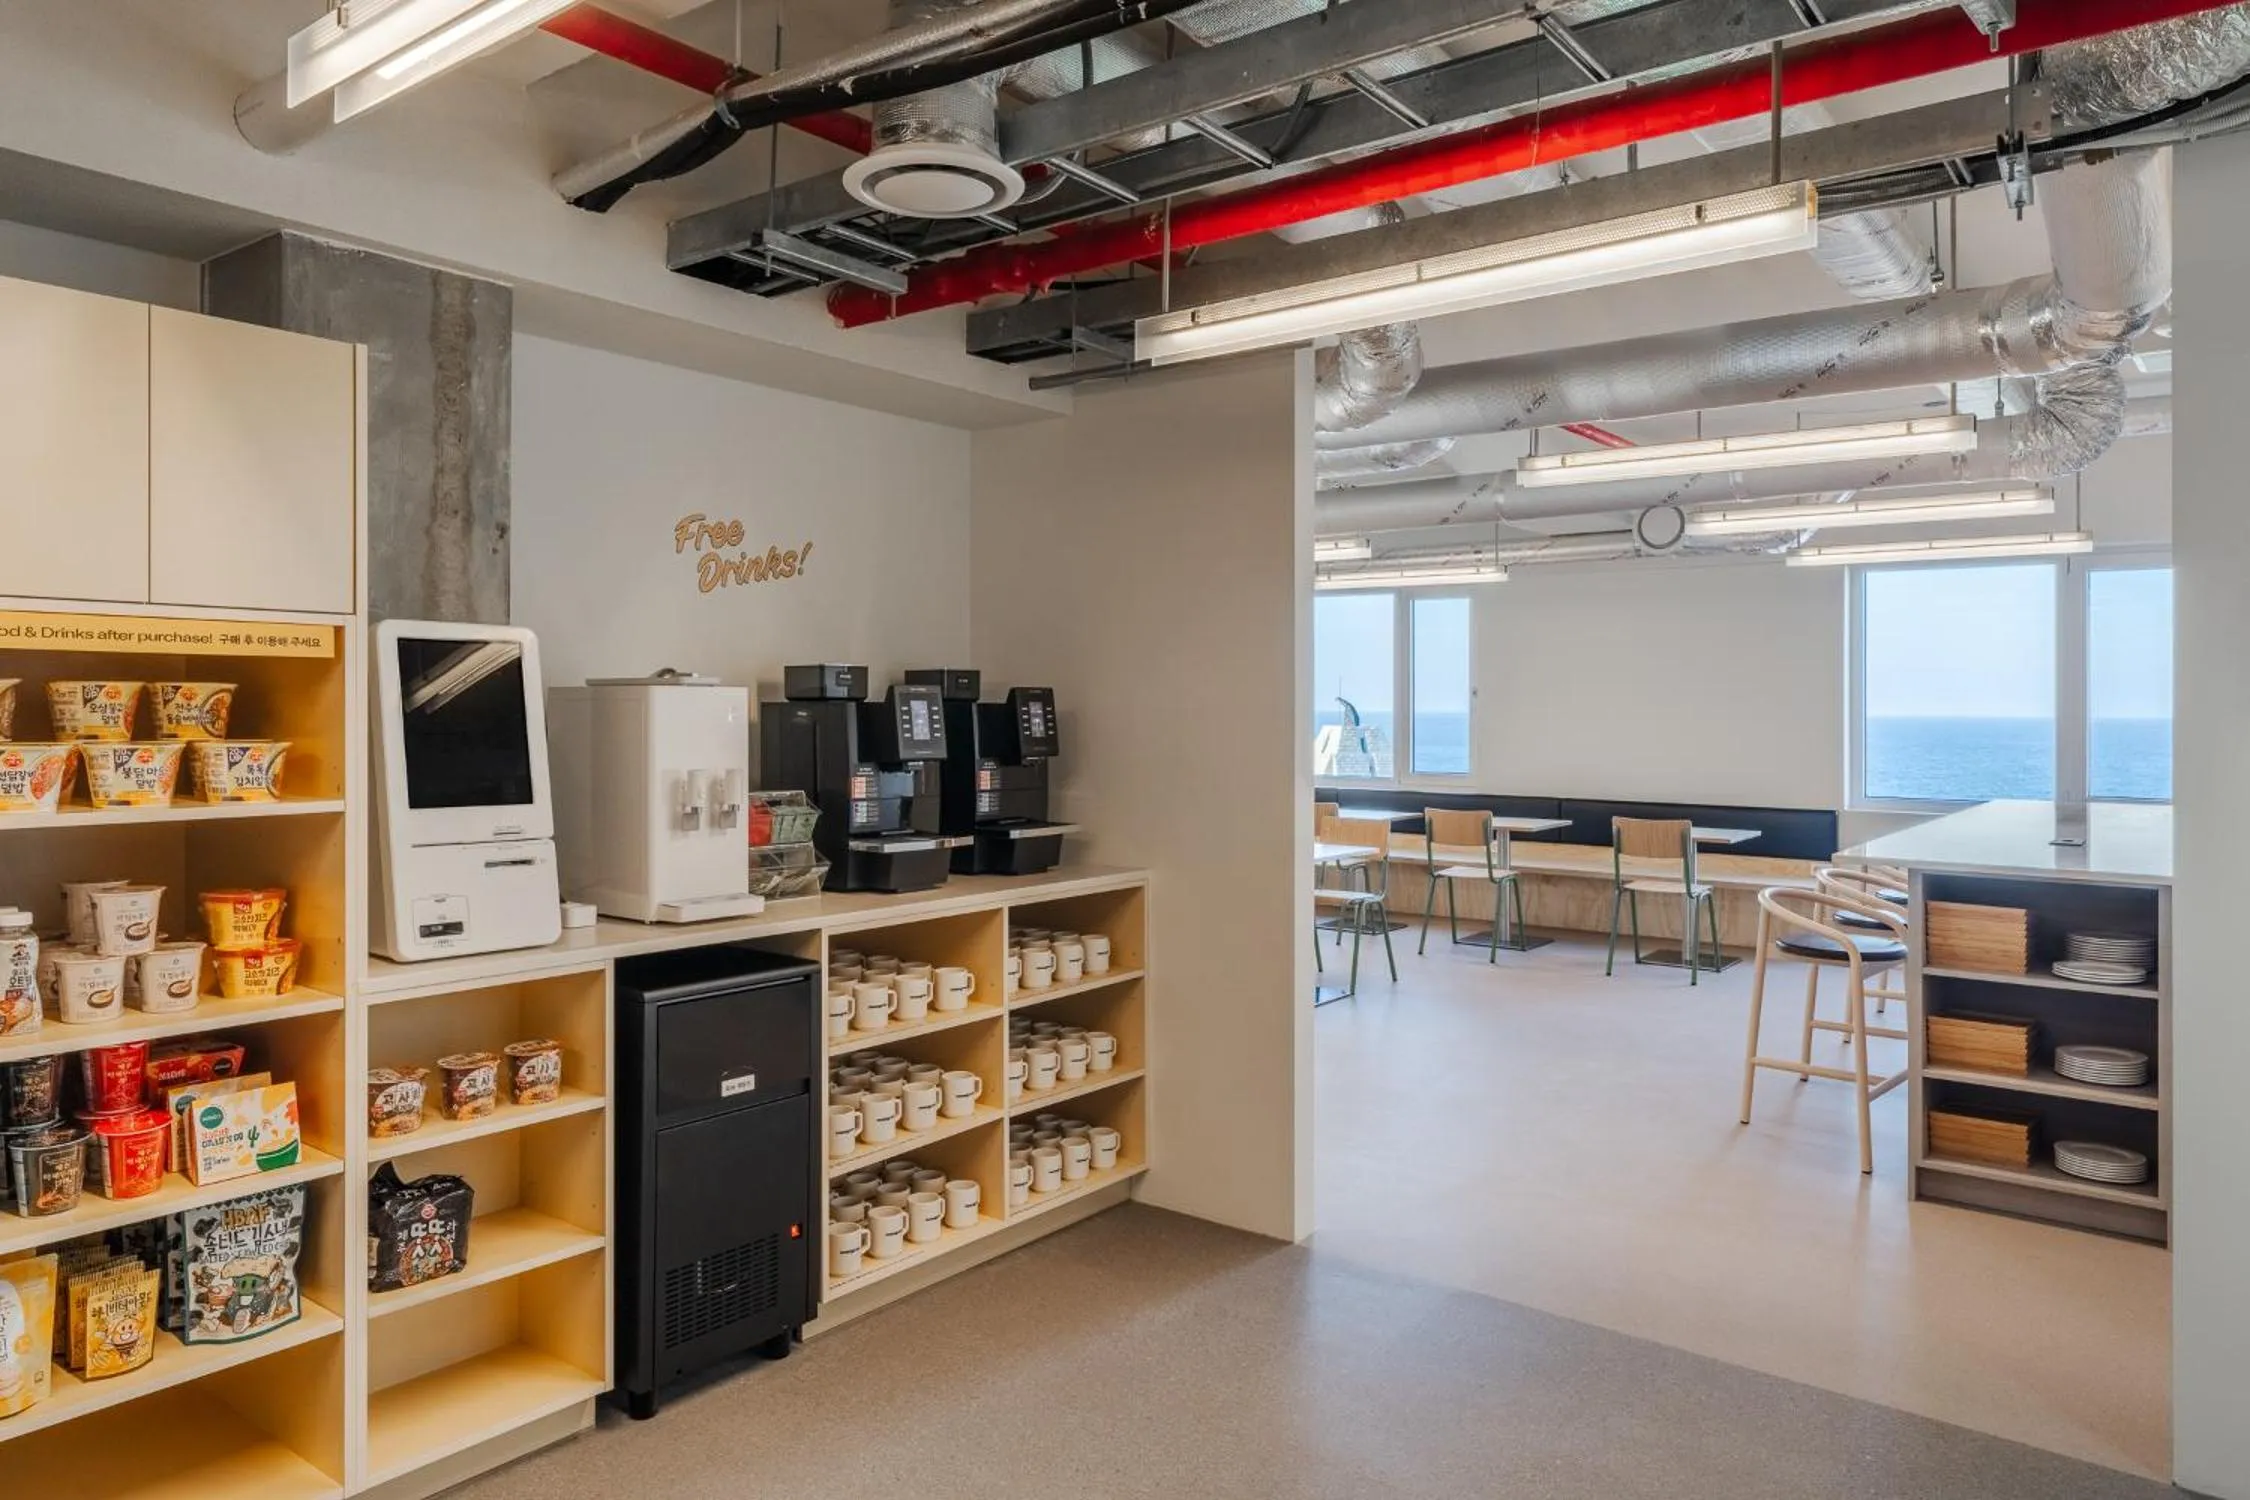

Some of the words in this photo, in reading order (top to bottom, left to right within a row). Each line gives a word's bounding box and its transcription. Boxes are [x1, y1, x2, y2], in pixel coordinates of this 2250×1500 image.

[673, 513, 745, 554] Free
[697, 541, 814, 593] Drinks!
[24, 626, 37, 638] &
[41, 626, 94, 640] Drinks
[97, 629, 135, 641] after
[137, 631, 213, 644] purchase!
[219, 633, 241, 645] 구매
[291, 636, 321, 647] 주세요
